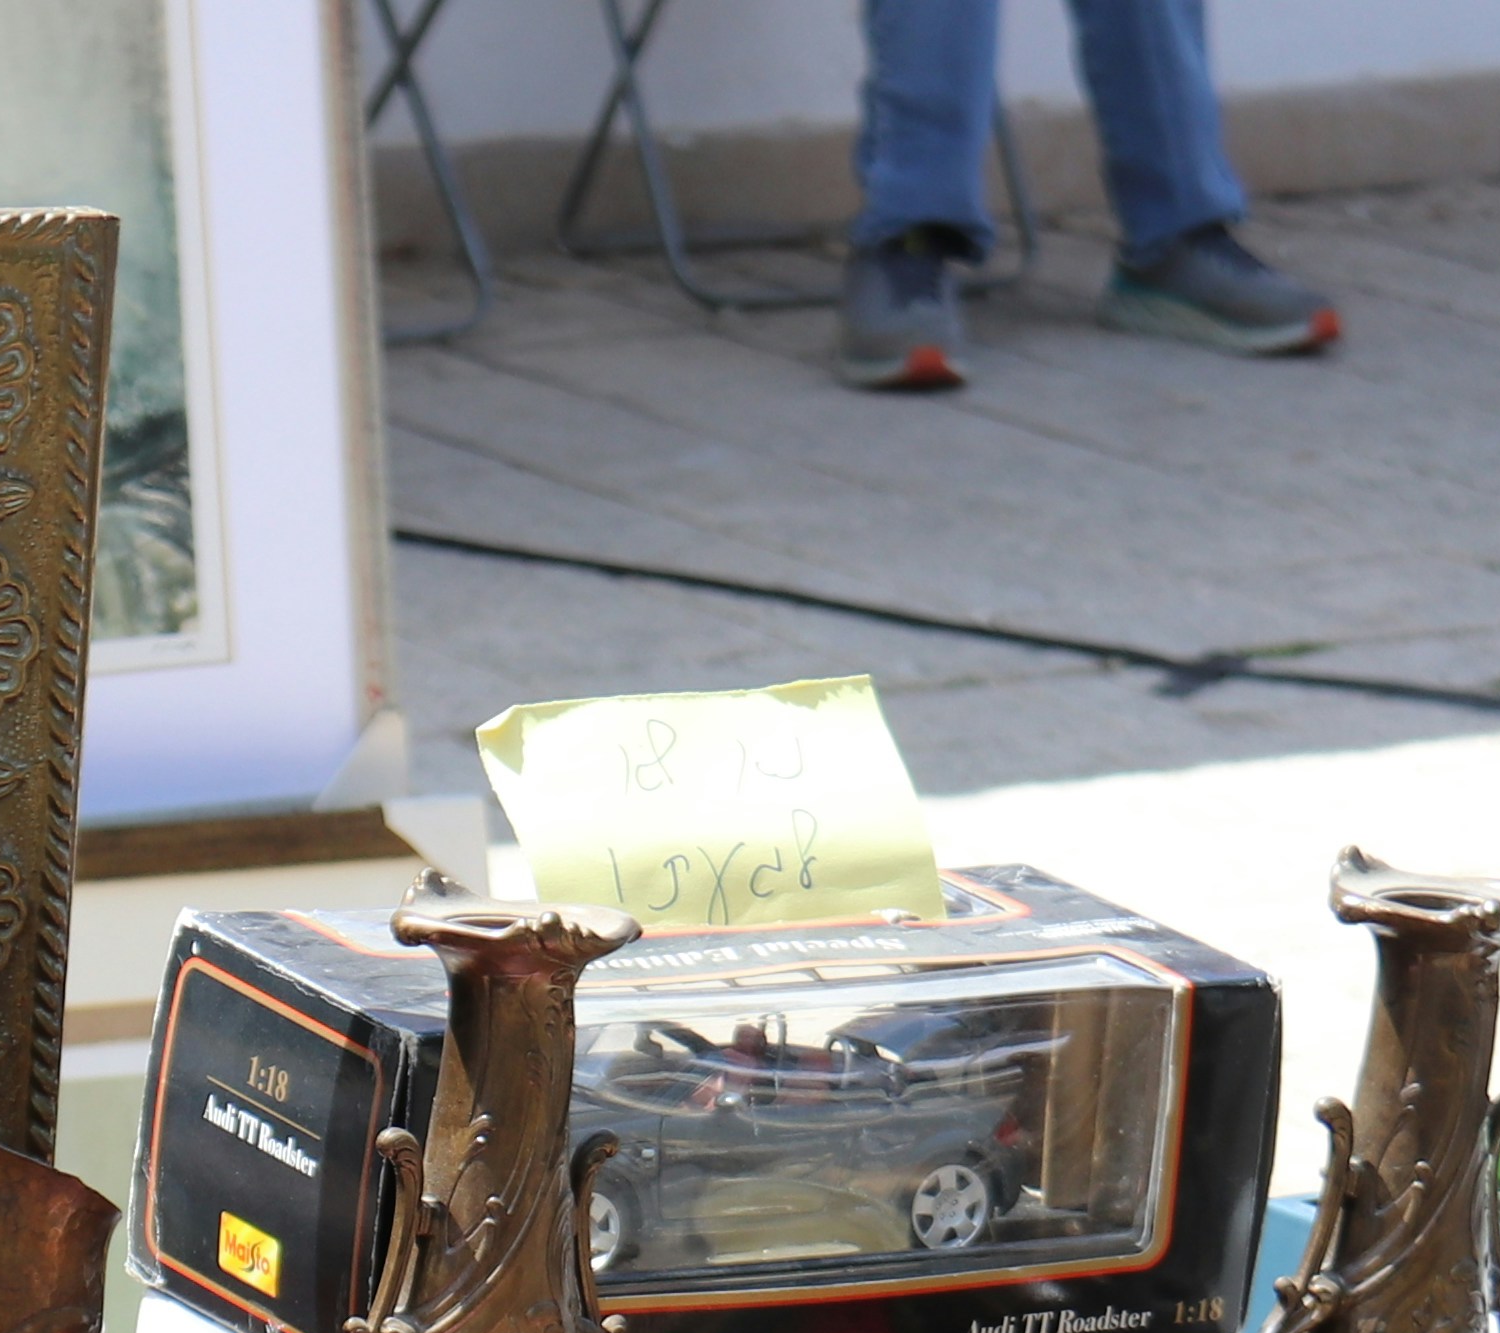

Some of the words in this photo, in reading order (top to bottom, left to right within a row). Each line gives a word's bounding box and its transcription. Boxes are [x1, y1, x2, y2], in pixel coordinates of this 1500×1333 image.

[246, 1055, 290, 1102] 1:18
[202, 1094, 237, 1128] Audi
[237, 1108, 260, 1146] TT
[258, 1122, 318, 1178] Roadster
[224, 1229, 272, 1276] Maisto
[1173, 1296, 1226, 1325] 1:18
